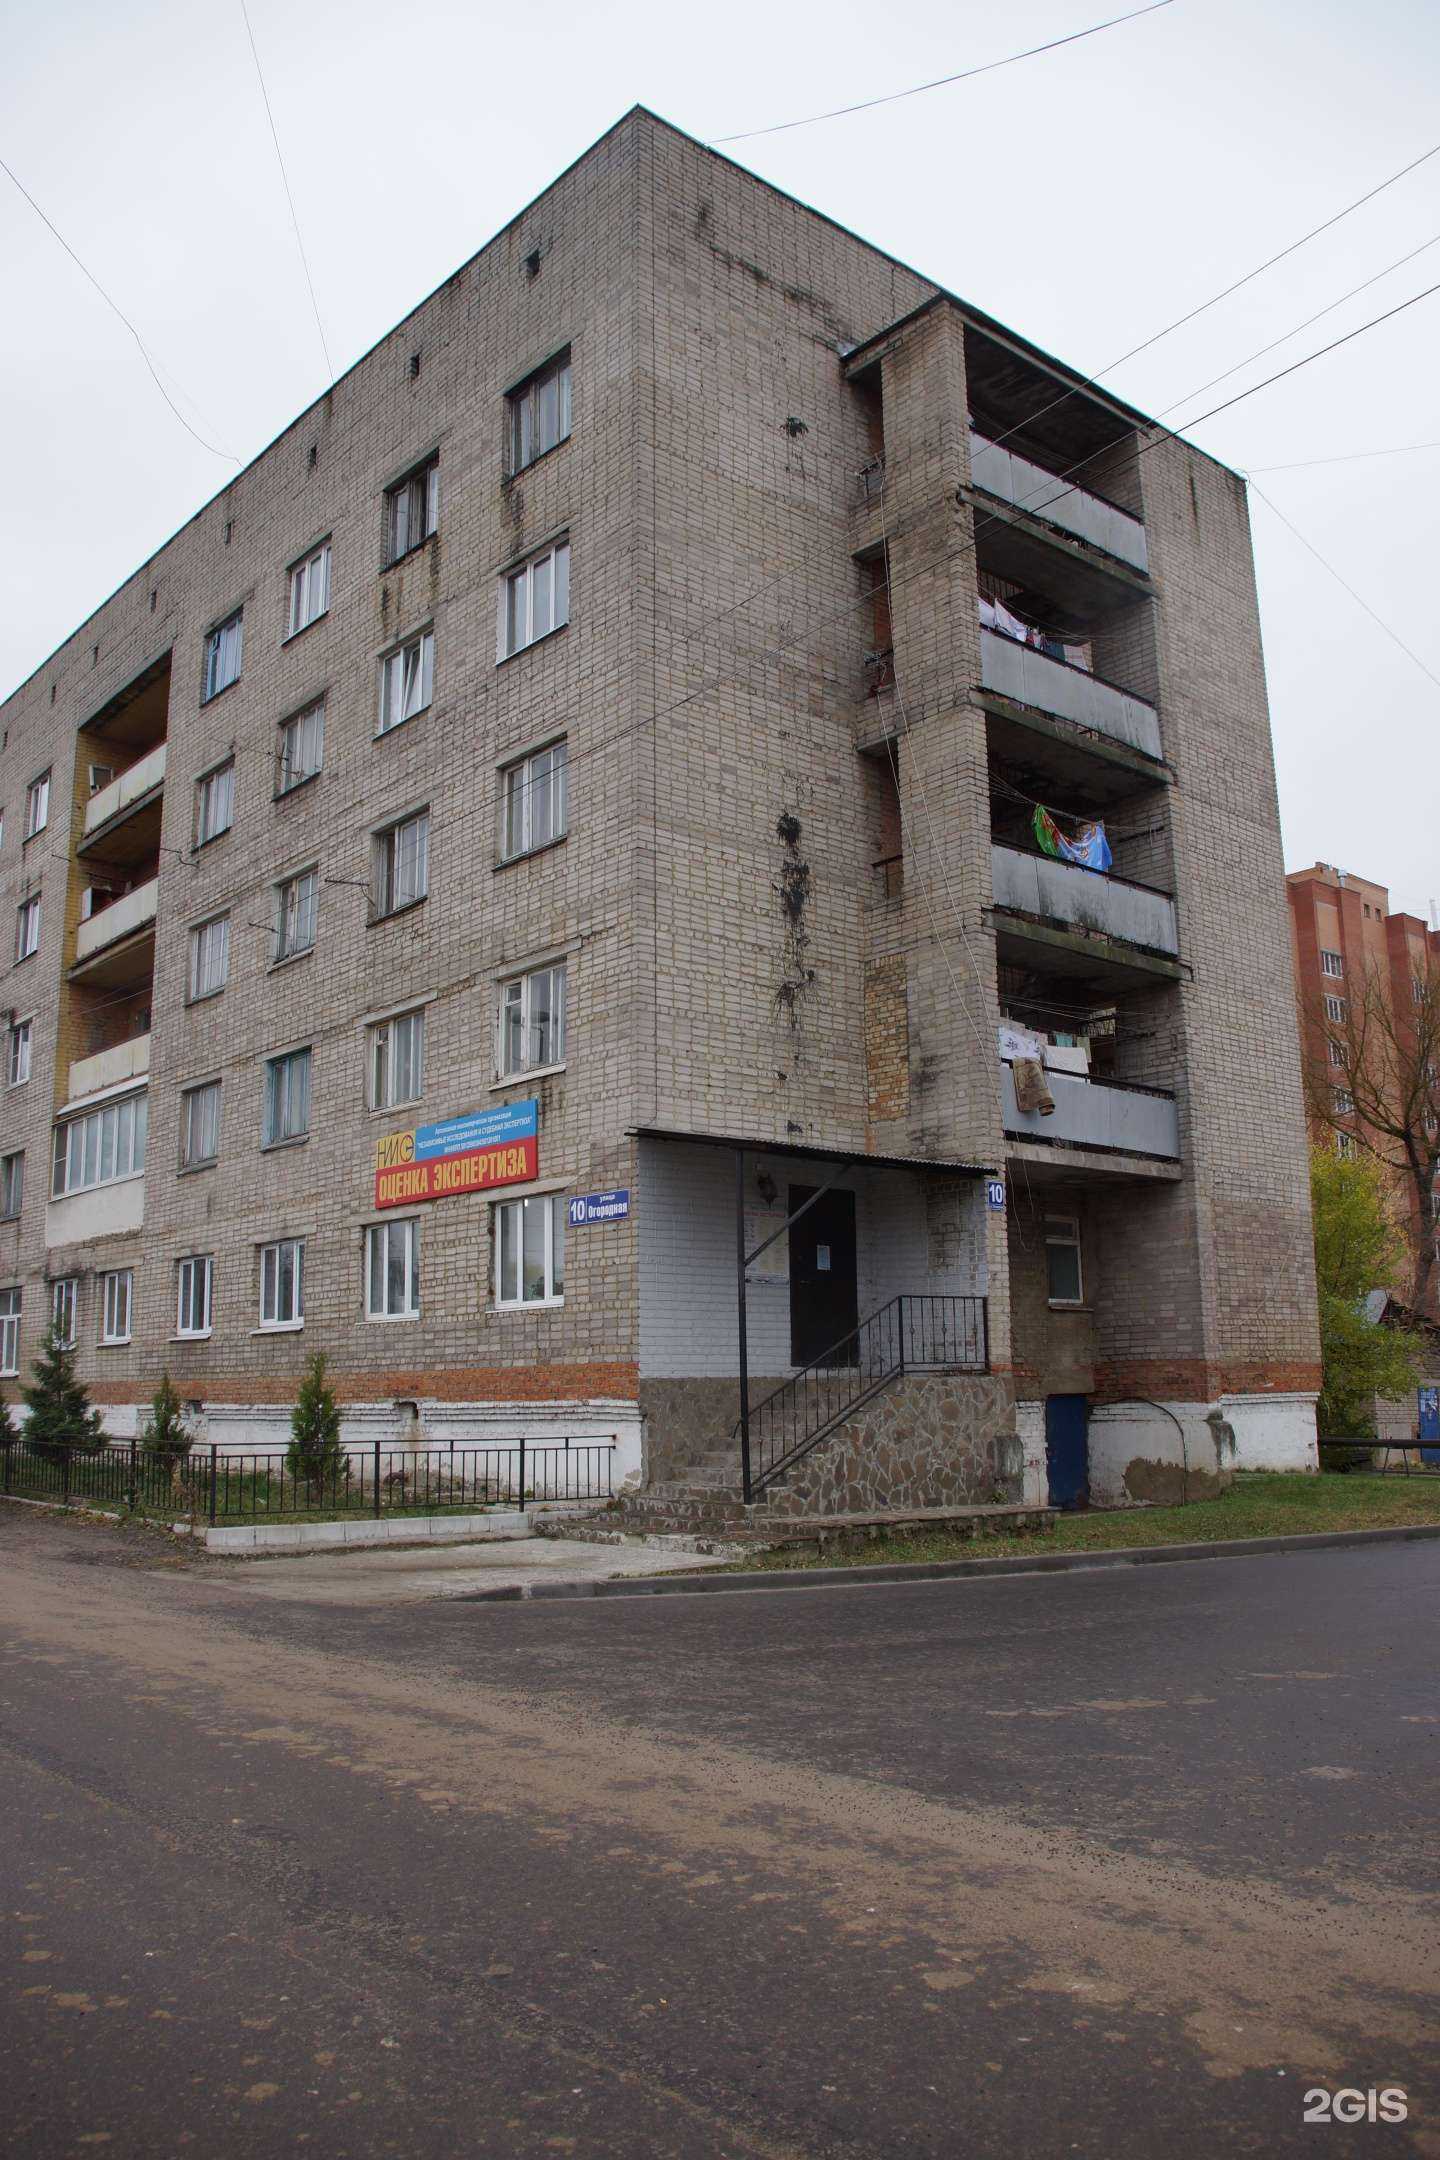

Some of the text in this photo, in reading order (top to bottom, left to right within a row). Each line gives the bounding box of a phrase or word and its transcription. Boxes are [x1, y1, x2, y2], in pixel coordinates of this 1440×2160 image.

[379, 1146, 528, 1202] ОЦЕНКА ЭКСПЕРТИЗА
[990, 1184, 1003, 1204] 10
[571, 1200, 628, 1222] 10 Огородная
